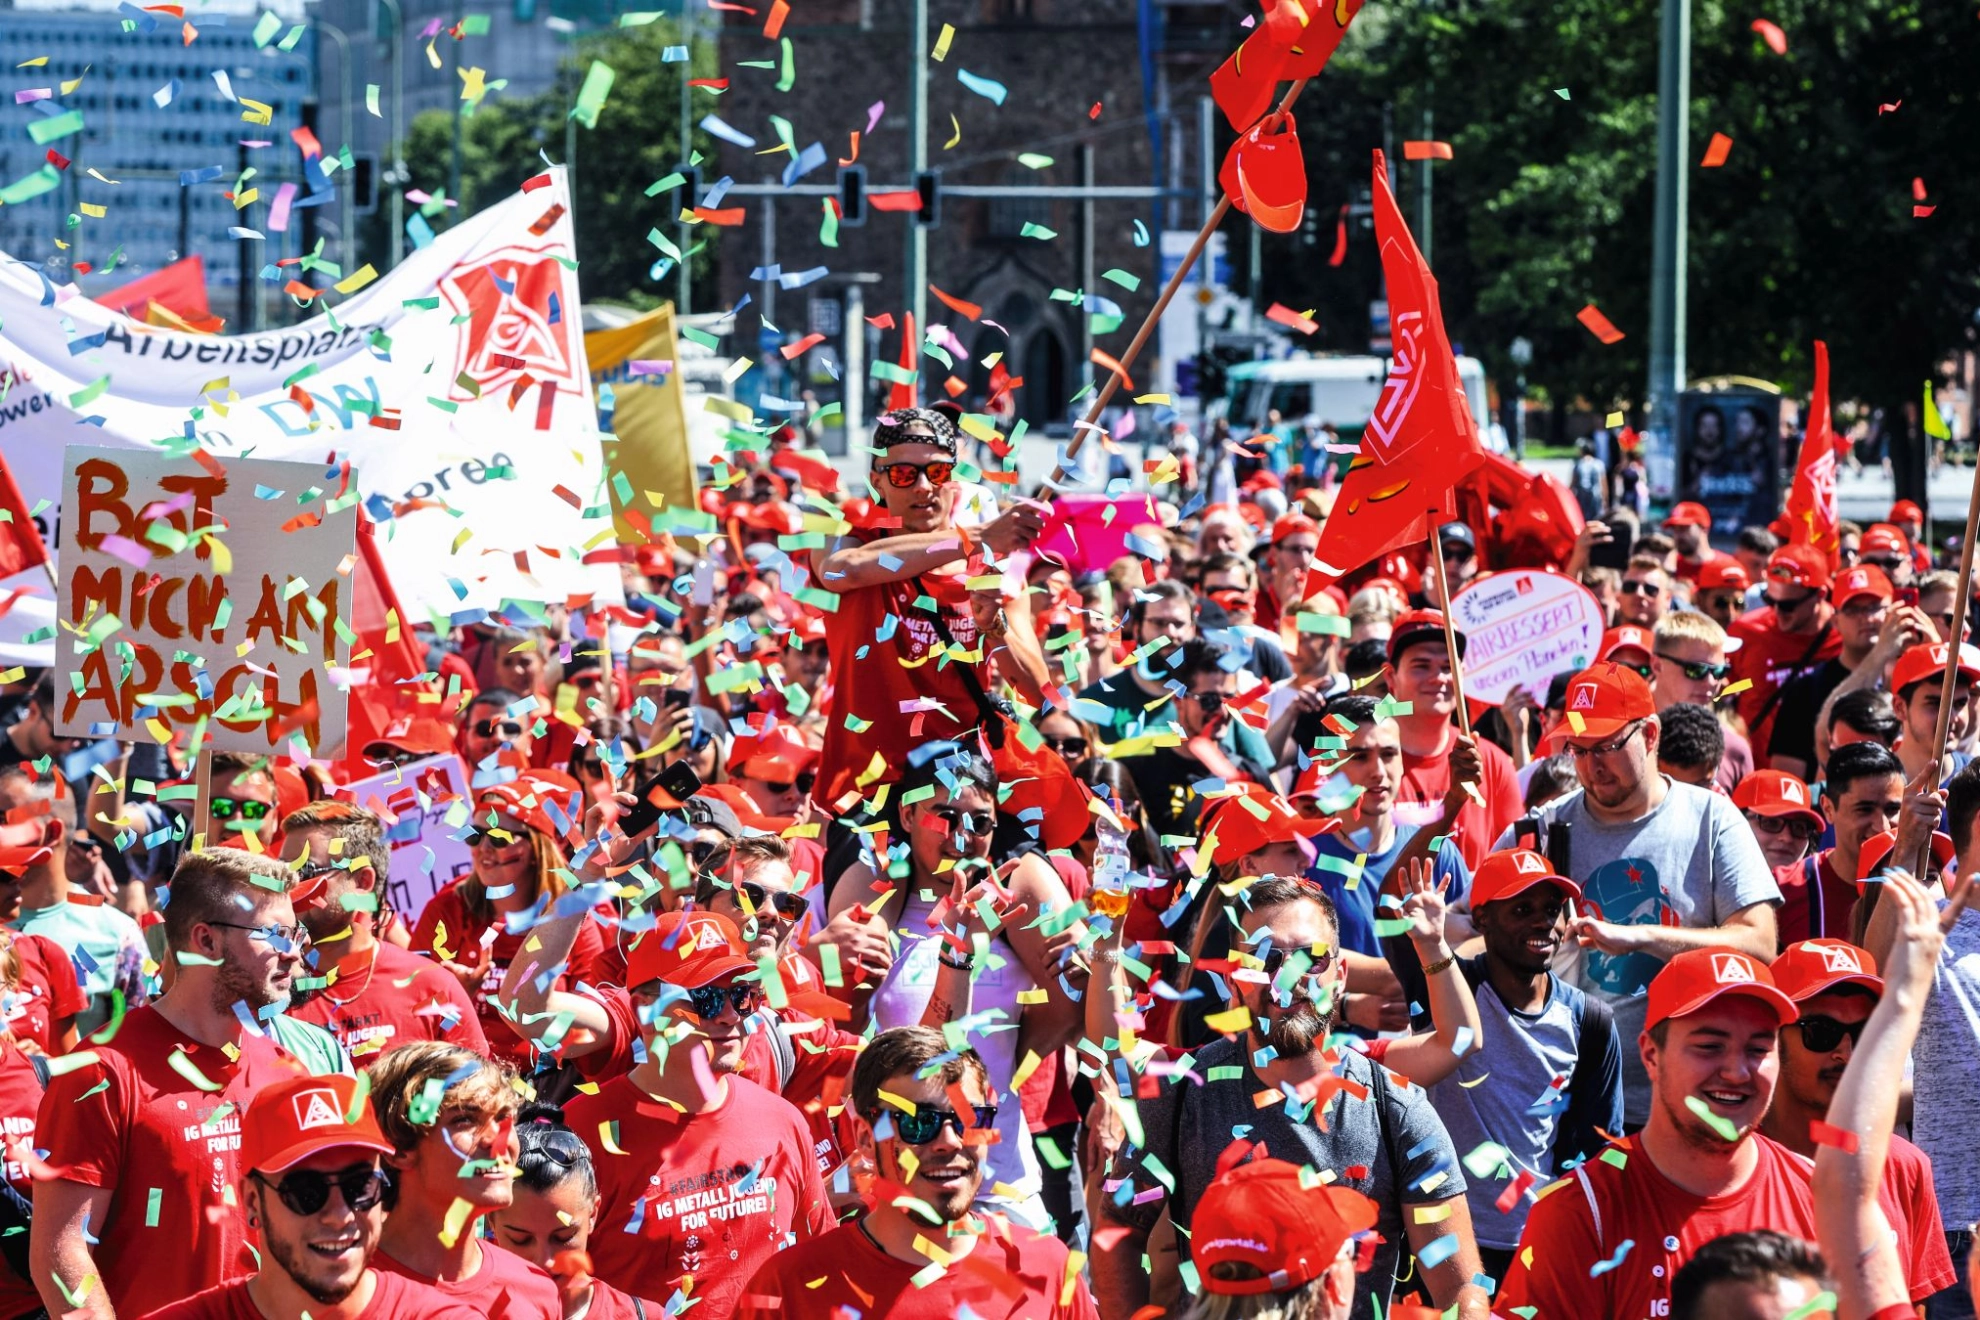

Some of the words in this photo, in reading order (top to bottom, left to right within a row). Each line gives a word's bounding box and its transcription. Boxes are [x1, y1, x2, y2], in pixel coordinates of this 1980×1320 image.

[71, 564, 228, 644] MICH
[244, 573, 339, 664] AM
[905, 617, 942, 633] META
[949, 617, 975, 631] JUGE
[62, 639, 321, 757] ARSCH
[184, 1125, 200, 1142] IG
[201, 1117, 242, 1138] METALL
[207, 1137, 229, 1154] FOR
[656, 1201, 674, 1220] IG
[674, 1187, 728, 1215] METALL
[681, 1211, 708, 1232] FOR
[708, 1195, 768, 1221] FUTURE!
[1650, 1298, 1670, 1318] IG
